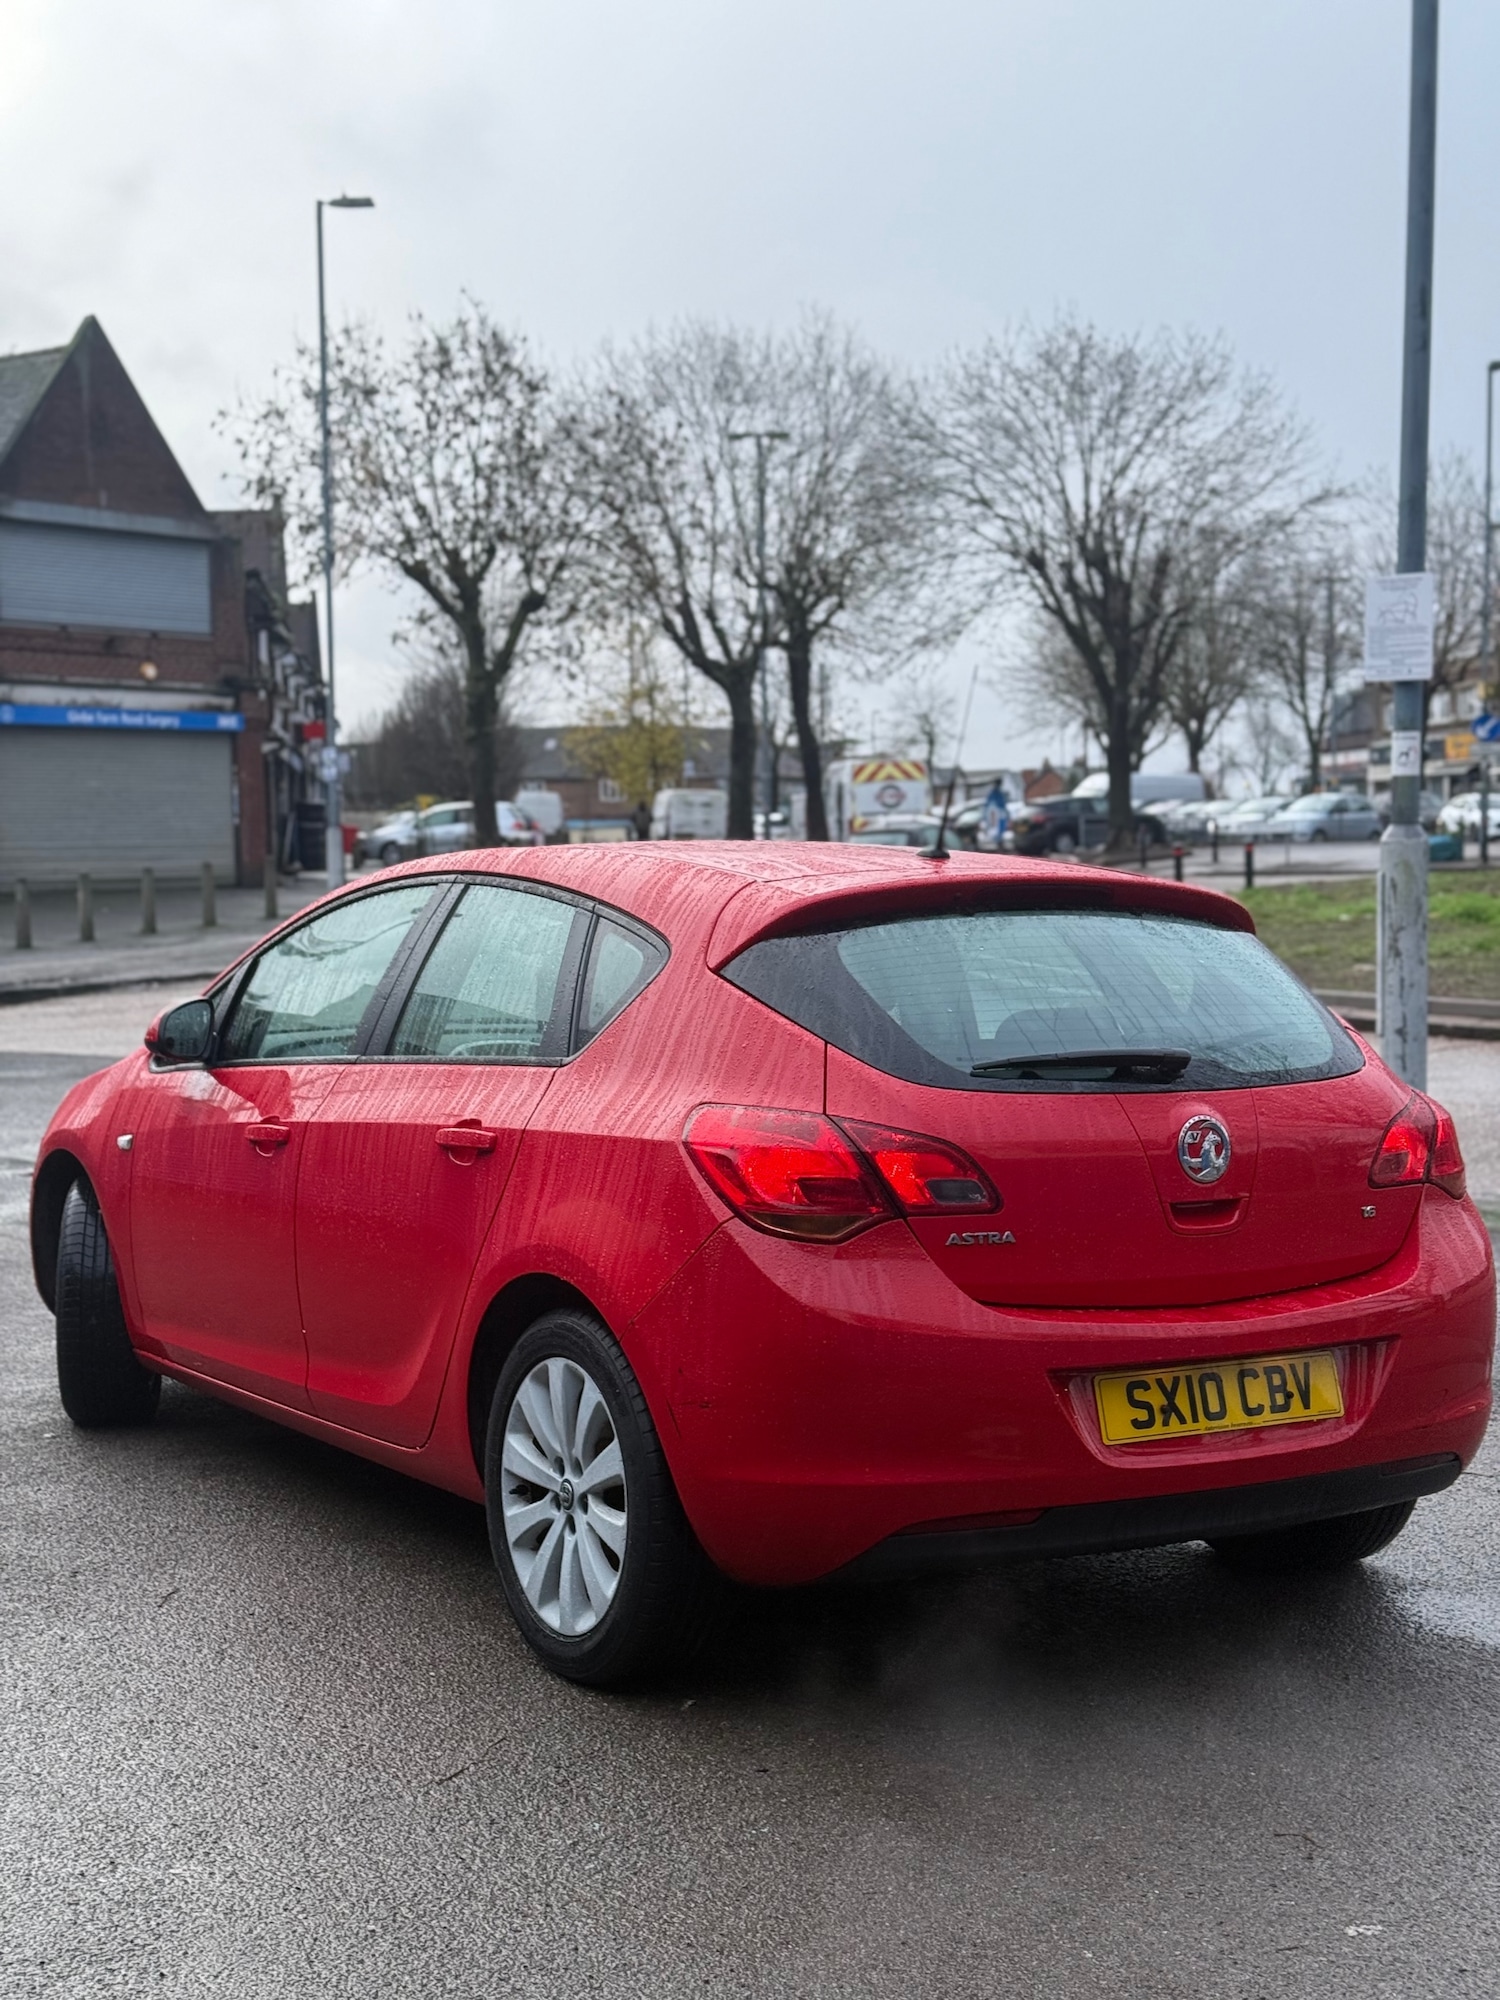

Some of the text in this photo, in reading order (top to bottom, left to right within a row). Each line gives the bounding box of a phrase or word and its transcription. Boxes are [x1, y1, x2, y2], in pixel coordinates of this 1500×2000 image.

[945, 1231, 1016, 1245] ASTRA
[1126, 1362, 1311, 1430] SX10 CBV
